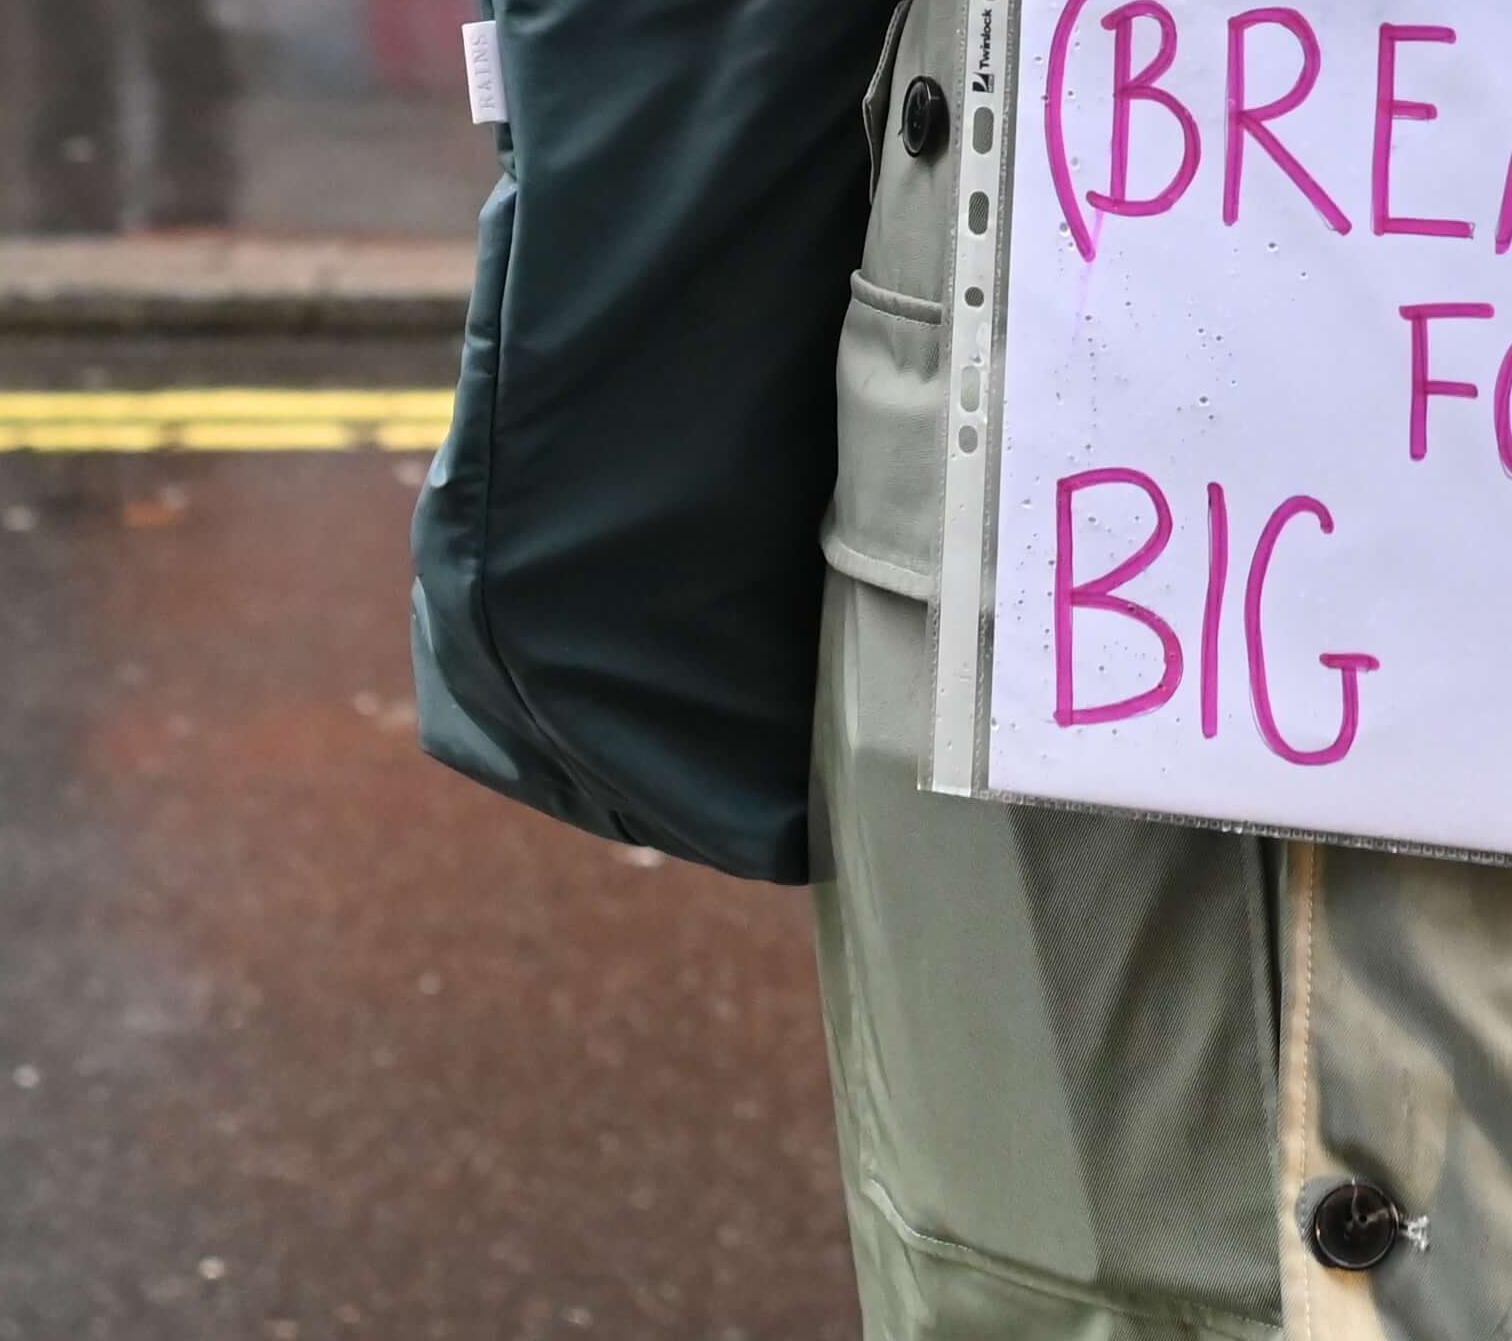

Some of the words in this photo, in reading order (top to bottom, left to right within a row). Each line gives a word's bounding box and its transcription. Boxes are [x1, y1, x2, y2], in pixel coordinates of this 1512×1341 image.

[471, 35, 495, 109] RAINS
[979, 9, 992, 69] Twinlock
[1054, 467, 1381, 767] BIG
